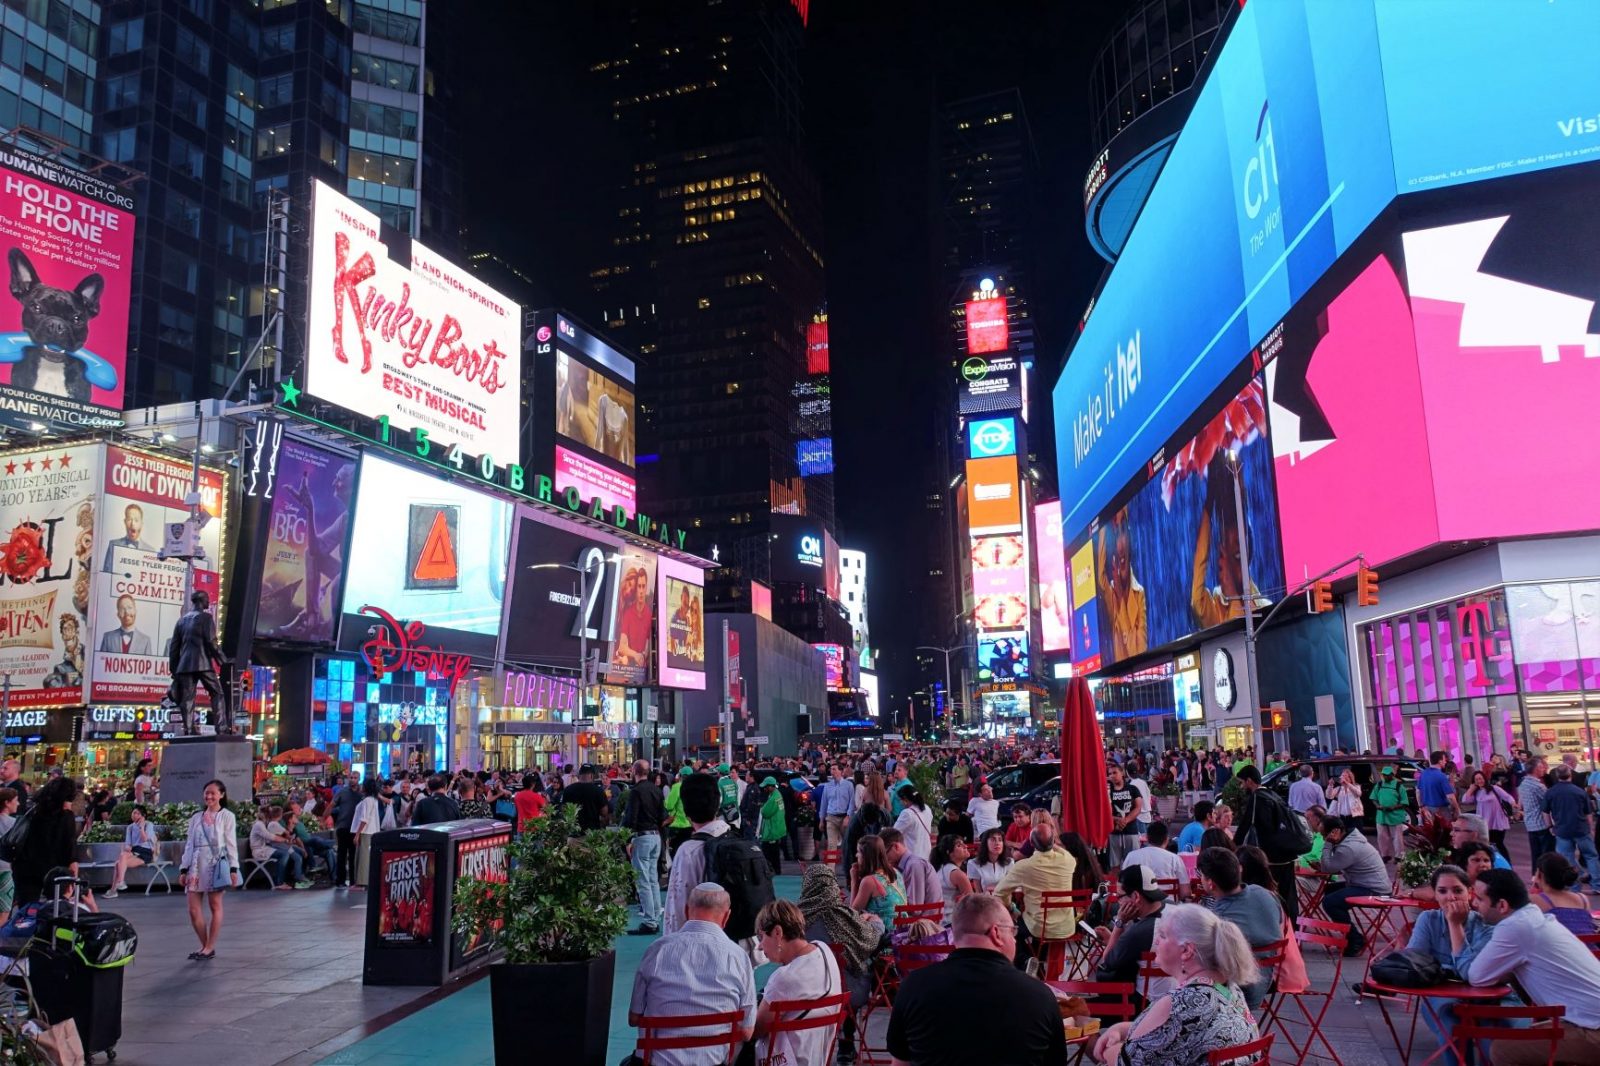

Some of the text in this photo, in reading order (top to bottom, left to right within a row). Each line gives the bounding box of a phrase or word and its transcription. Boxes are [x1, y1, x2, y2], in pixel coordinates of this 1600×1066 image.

[29, 154, 43, 163] OUT
[43, 160, 64, 172] ABOUT
[65, 167, 76, 176] THE
[77, 172, 107, 189] DECEPTION
[1466, 164, 1496, 175] Member
[1518, 157, 1537, 167] Make
[1545, 152, 1563, 161] Here
[5, 176, 119, 231] HOLD THE
[21, 201, 103, 244] PHONE
[14, 219, 45, 236] Humane
[47, 231, 73, 247] Society
[75, 240, 82, 248] of
[84, 243, 96, 253] the
[98, 248, 120, 261] United
[23, 233, 39, 245] only
[40, 239, 60, 251] gives
[75, 249, 82, 257] of
[83, 253, 92, 262] its
[94, 258, 119, 270] millions
[1250, 231, 1264, 256] The
[22, 242, 97, 270] to local pet shelters?
[422, 263, 442, 279] AND
[973, 290, 998, 300] 2016
[332, 231, 507, 394] Kinky Boots
[566, 325, 575, 338] LG
[1261, 322, 1284, 351] MARRIOTT
[538, 344, 551, 353] LG
[1262, 337, 1283, 362] MARQUIS
[969, 378, 1008, 388] CONGRATS
[3, 388, 24, 398] YOUR
[25, 391, 49, 404] LOCAL
[83, 405, 99, 414] NOT
[383, 372, 487, 431] BEST MUSICAL
[1073, 393, 1102, 469] Make
[1104, 360, 1115, 425] it
[43, 469, 90, 488] MUSICAL
[112, 464, 155, 494] COMIC
[145, 459, 165, 473] TYLER
[166, 465, 193, 481] FERGUSO
[272, 513, 306, 544] BFG
[801, 536, 820, 556] ON
[119, 557, 188, 573] JESSE TYLER FERGUS
[140, 571, 183, 588] FULLY
[1, 597, 46, 608] METHING
[578, 547, 622, 641] 21
[357, 604, 471, 698] Disney
[1457, 602, 1492, 687] T
[154, 661, 172, 675] LAU
[504, 672, 577, 709] FOREVER
[93, 708, 135, 722] GIFTS
[151, 723, 165, 731] NY
[385, 855, 428, 882] JERSEY
[461, 846, 508, 879] JERSEY BOYS
[390, 879, 420, 904] BOYS
